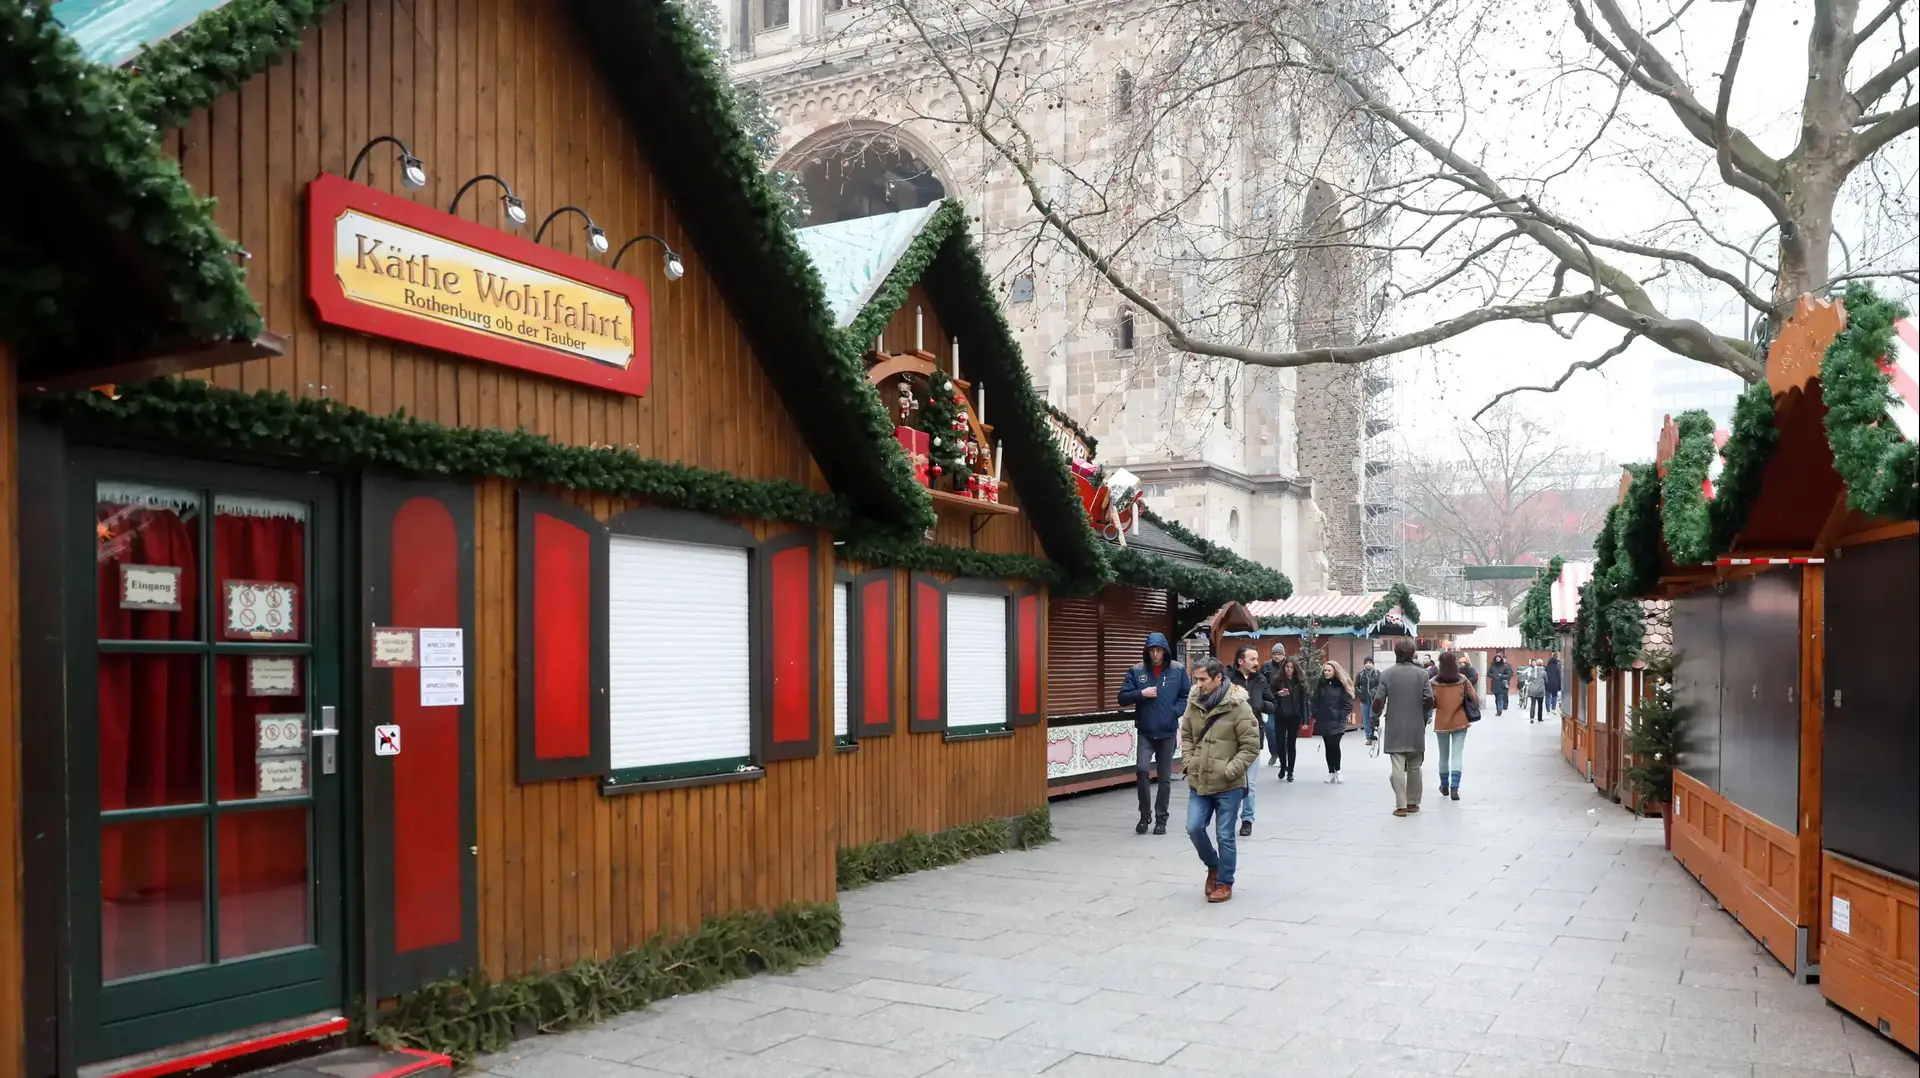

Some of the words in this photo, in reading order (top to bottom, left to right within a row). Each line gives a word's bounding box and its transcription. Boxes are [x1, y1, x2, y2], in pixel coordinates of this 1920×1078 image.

[355, 233, 461, 294] Käthe
[473, 268, 622, 341] Wohlfahrt
[404, 288, 491, 328] Rothenburg
[496, 315, 513, 332] ob
[517, 321, 539, 338] der
[543, 326, 587, 350] Tauber
[131, 579, 171, 593] Eingang
